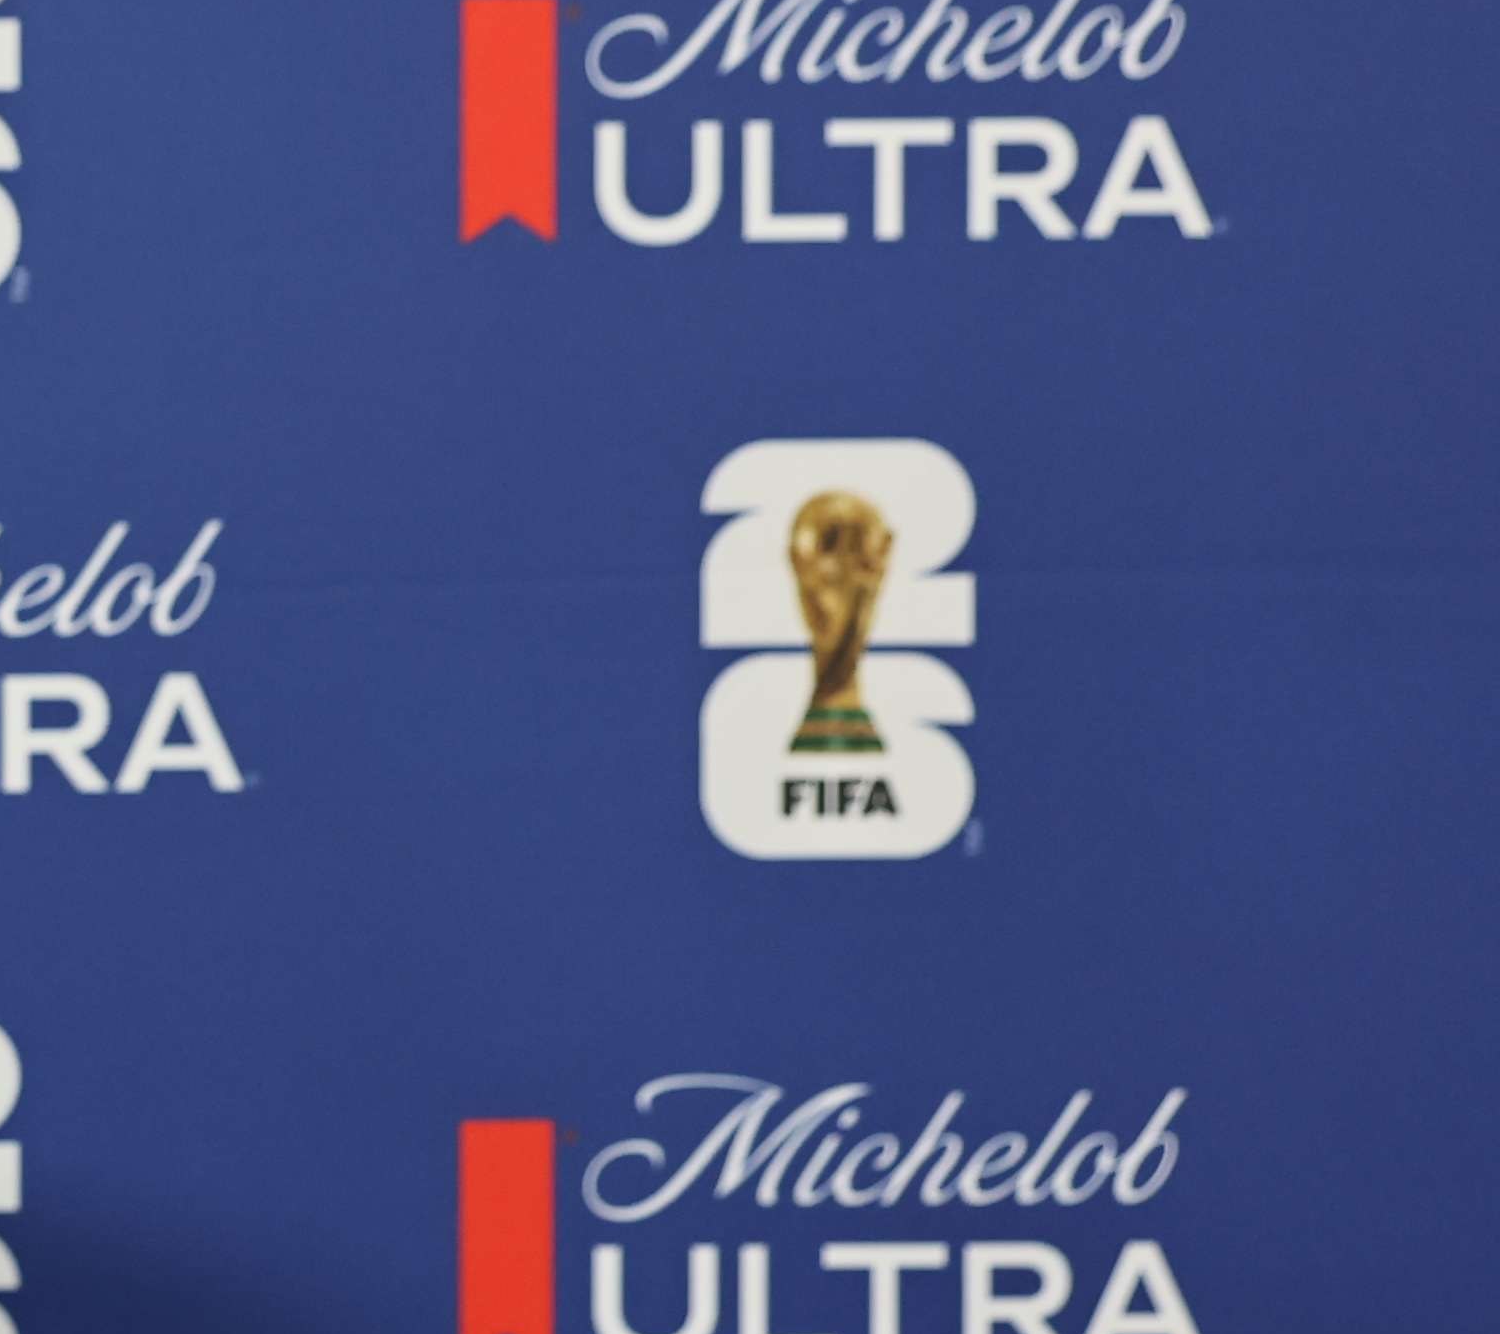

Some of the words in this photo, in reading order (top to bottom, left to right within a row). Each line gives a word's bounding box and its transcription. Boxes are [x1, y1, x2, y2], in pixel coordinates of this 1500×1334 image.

[594, 118, 1213, 246] ULTRA
[782, 778, 898, 817] FIFA
[583, 1074, 1186, 1222] Michelob
